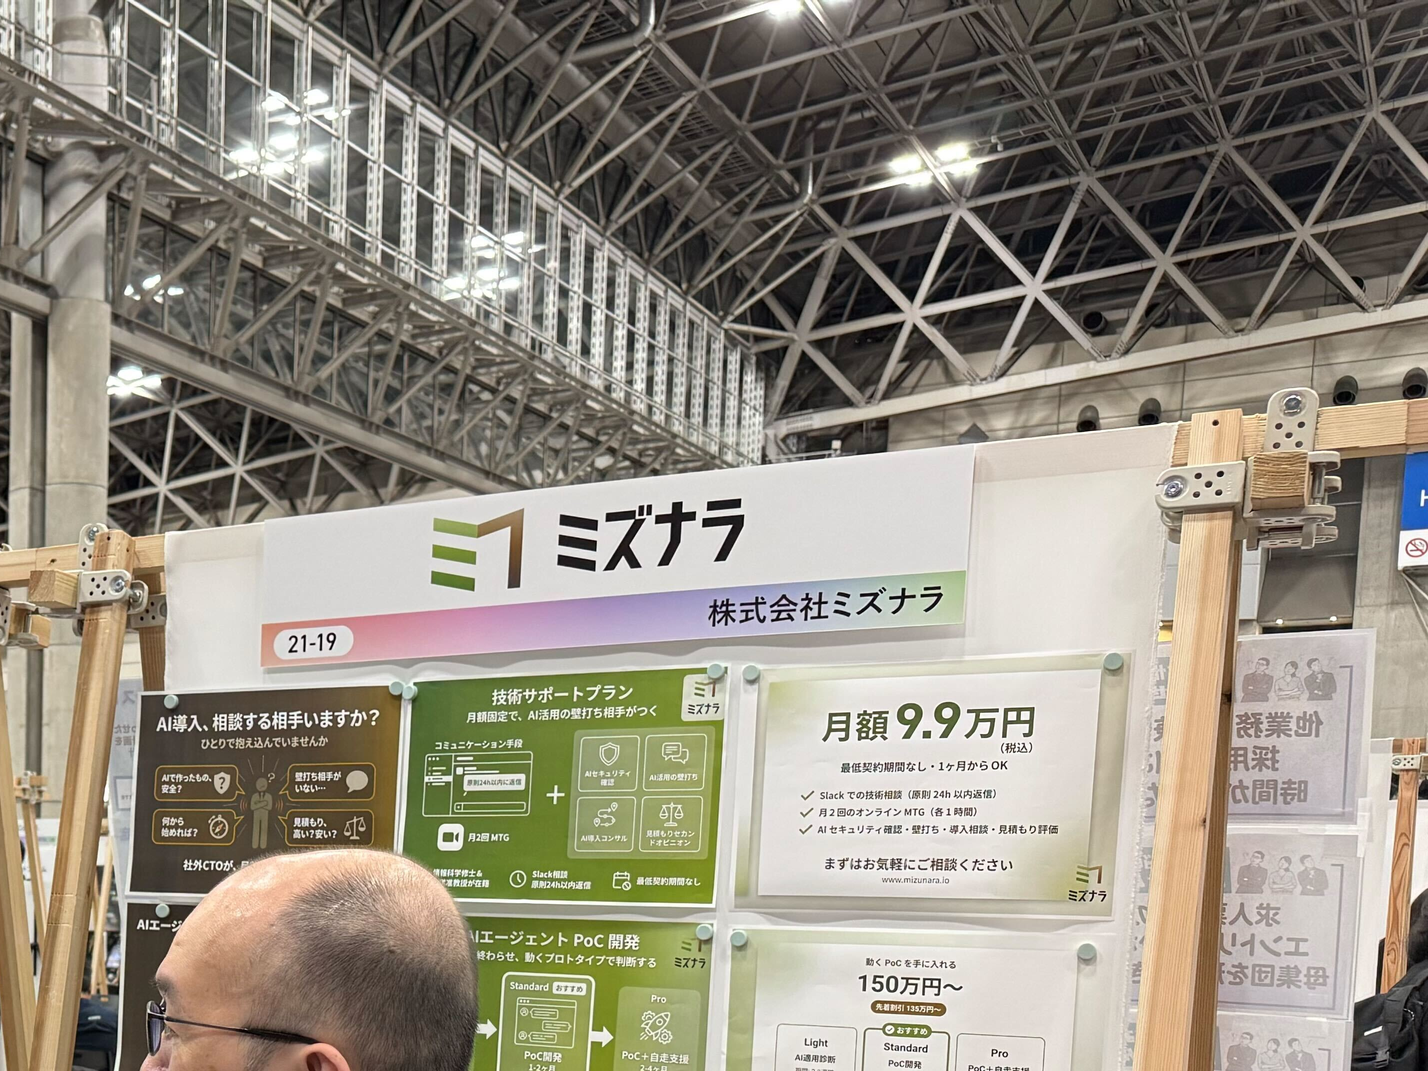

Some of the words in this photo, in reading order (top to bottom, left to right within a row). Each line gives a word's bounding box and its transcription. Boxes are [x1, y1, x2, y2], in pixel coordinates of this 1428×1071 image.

[557, 497, 745, 572] ミズナラ
[708, 584, 945, 629] 株式会社ミズナラ
[287, 632, 337, 654] 21-19
[492, 685, 633, 706] 技術サポートプラン
[687, 702, 720, 715] ミズナラ
[157, 709, 379, 733] AI導入、相談する相手いますか？
[201, 736, 328, 749] ひとりで抱え込んでいませんか
[434, 739, 523, 750] コミュニケーション手段
[162, 773, 212, 783] AIで作ったもの、
[295, 771, 341, 782] 壁打ち相手が
[585, 769, 631, 779] AIセキュリティ
[600, 777, 615, 786] 確認
[162, 784, 182, 794] 安全？
[162, 817, 184, 826] 何から
[293, 818, 328, 827] 見積もり、
[162, 828, 198, 837] 始めれば？
[293, 829, 337, 839] 高い？安い？
[468, 833, 489, 843] 月2回
[491, 833, 509, 843] MTG
[183, 859, 255, 871] 社外CTOが、
[824, 857, 1013, 872] まずはお気軽にご相談ください
[532, 870, 568, 879] Slack相談
[882, 875, 950, 885] www.mizunara.io
[636, 876, 701, 887] 最低契約期間なし
[1068, 889, 1107, 902] ミズナラ
[573, 933, 604, 948] PoC
[608, 933, 640, 951] 開発
[674, 957, 706, 969] ミズナラ
[865, 957, 881, 968] 動く
[884, 958, 901, 968] PoC
[904, 959, 957, 970] を手に入れる
[510, 982, 549, 992] Standard
[651, 995, 667, 1004] Pro
[896, 1026, 928, 1036] おすすめ
[804, 1038, 828, 1048] Light
[884, 1042, 929, 1054] Standard
[524, 1051, 562, 1063] PoC開発
[990, 1048, 1009, 1058] Pro
[888, 1058, 922, 1070] PoC開発
